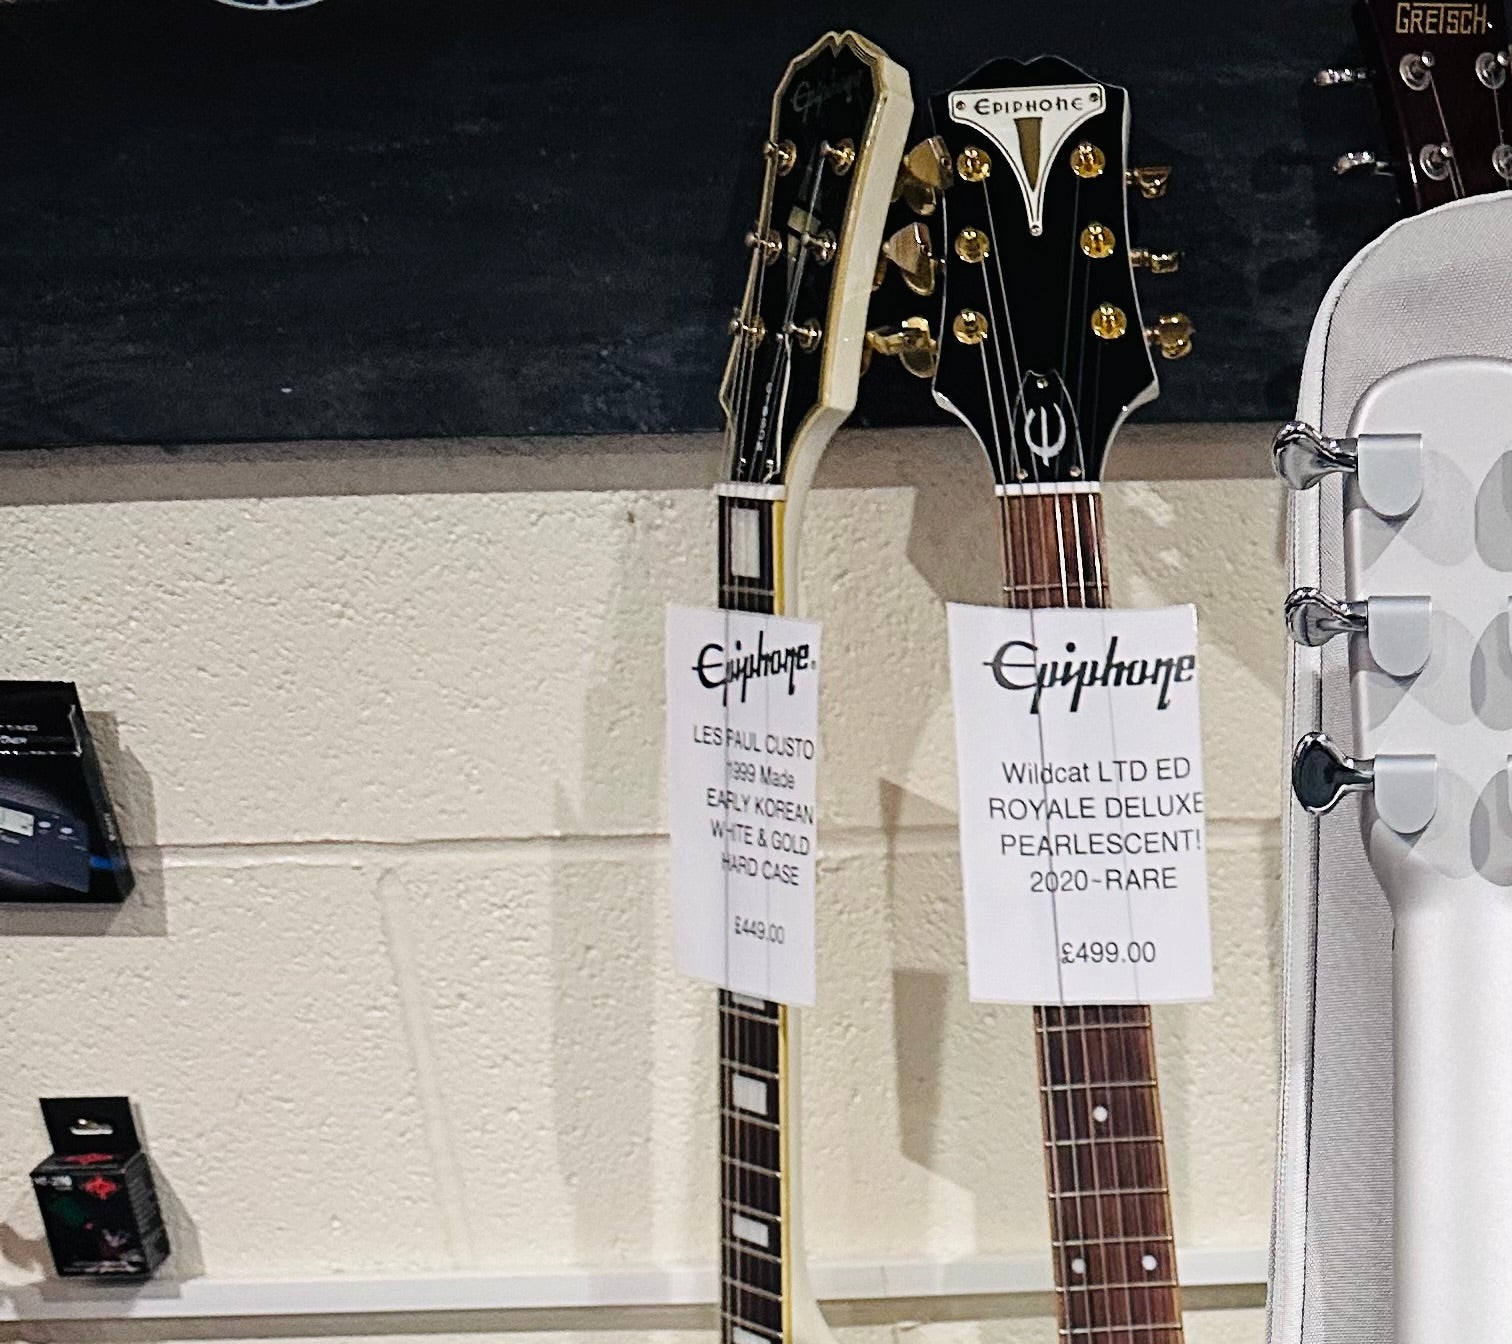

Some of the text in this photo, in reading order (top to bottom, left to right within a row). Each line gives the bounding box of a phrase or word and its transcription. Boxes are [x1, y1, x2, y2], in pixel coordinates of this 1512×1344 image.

[1395, 2, 1487, 35] GRETSCH
[692, 630, 810, 707] Epiphone
[982, 636, 1196, 715] Epiphone
[693, 724, 723, 746] LES
[726, 727, 760, 752] PAUL
[727, 760, 795, 789] 1999 Made
[1001, 757, 1191, 785] Wildcat LTD ED
[706, 788, 814, 825] EARLY KOREAN
[989, 791, 1204, 821] ROYALE DELUXE
[710, 818, 810, 856] WHITE & GOLD
[1001, 828, 1202, 857] PEARLESCENT!
[721, 850, 800, 887] HARD CASE
[733, 915, 785, 945] £449.00
[1061, 941, 1156, 964] £499.00
